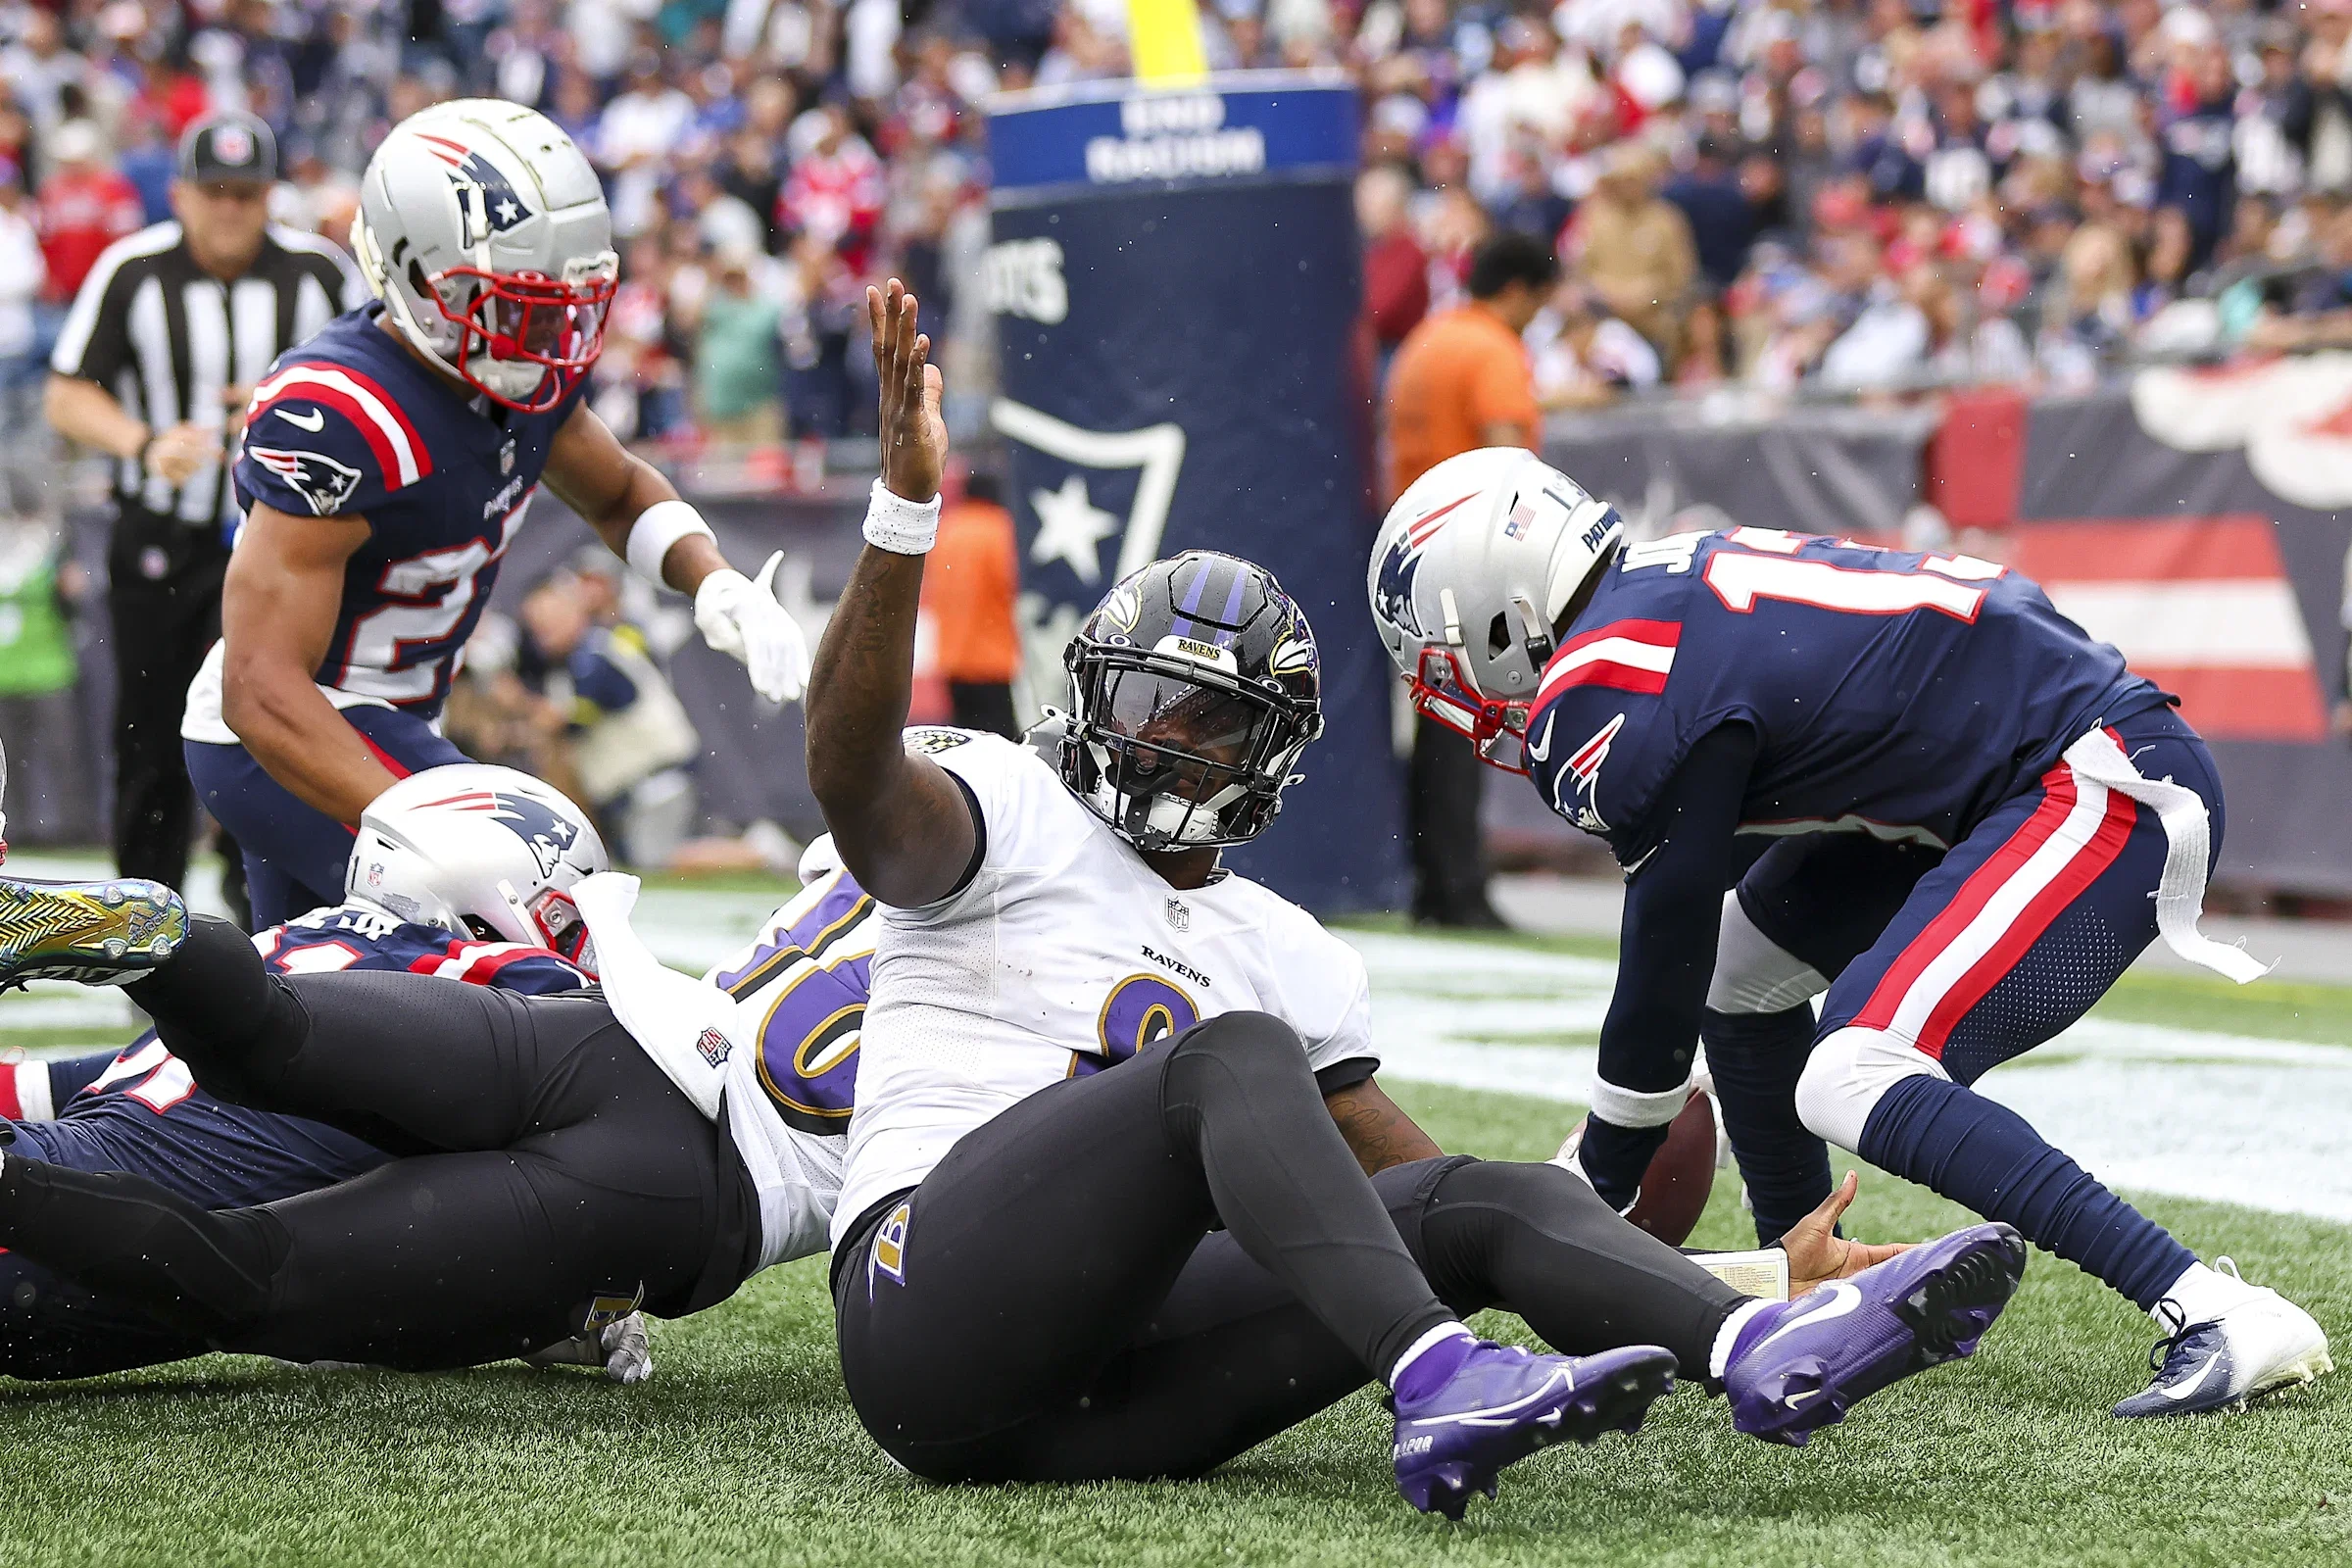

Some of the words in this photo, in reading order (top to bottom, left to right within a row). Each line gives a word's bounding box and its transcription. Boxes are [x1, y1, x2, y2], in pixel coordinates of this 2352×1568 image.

[1177, 638, 1221, 662] RAVENS
[128, 911, 170, 946] adidas
[1140, 945, 1211, 988] RAVENS
[699, 1029, 722, 1054] NFL
